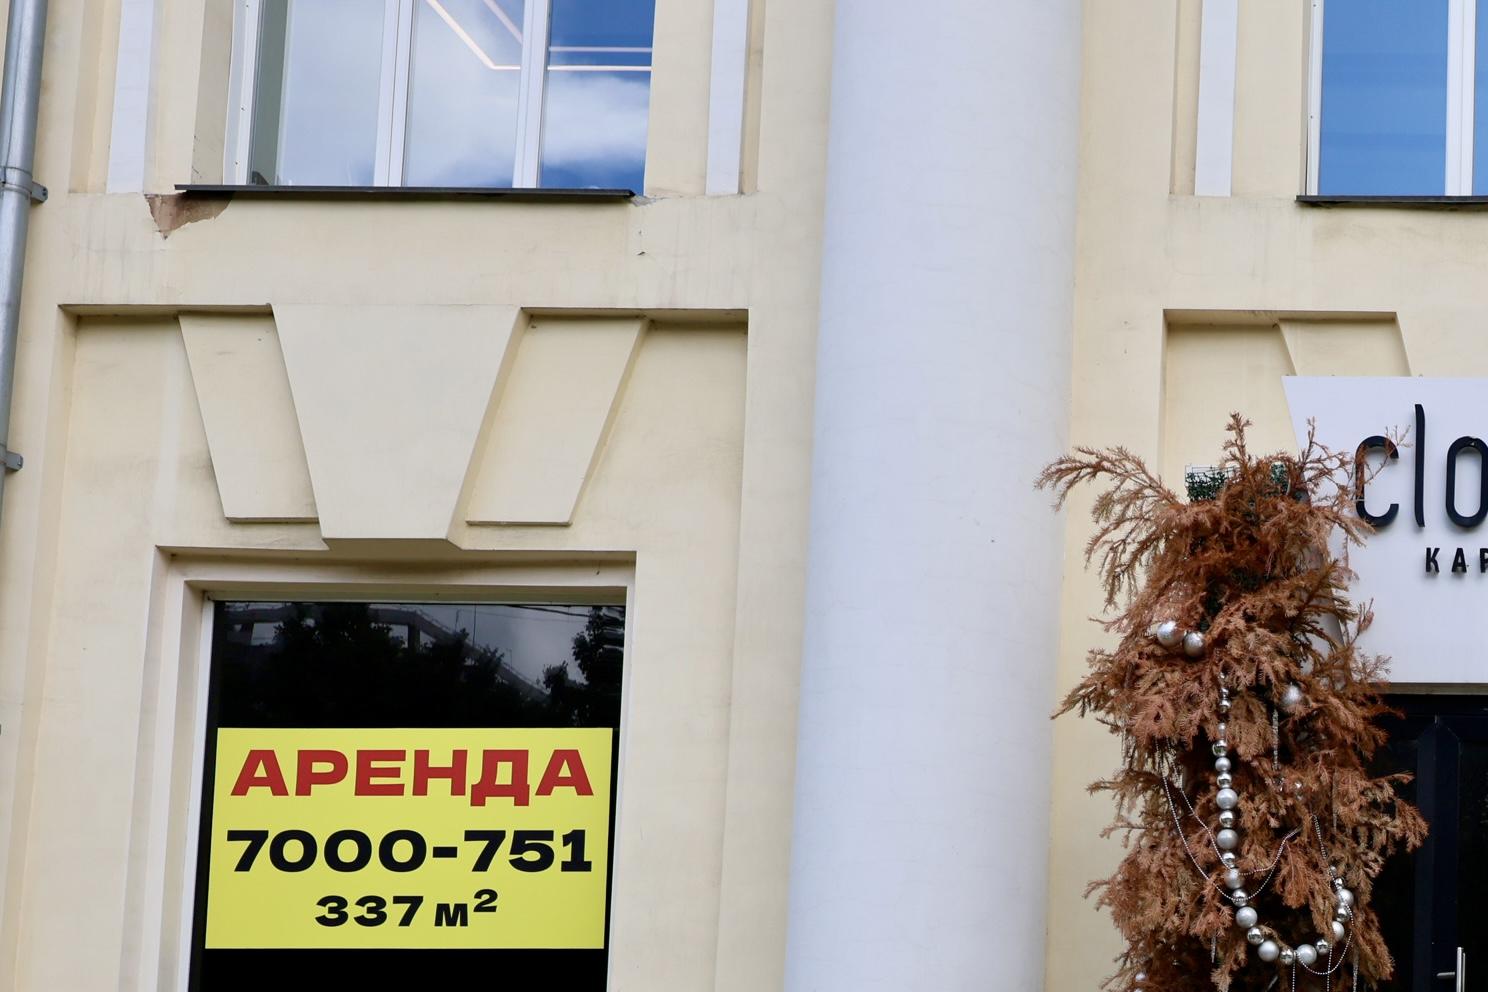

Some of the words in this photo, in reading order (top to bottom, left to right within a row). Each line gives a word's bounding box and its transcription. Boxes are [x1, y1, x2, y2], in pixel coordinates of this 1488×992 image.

[230, 749, 594, 807] АРЕНДА
[226, 829, 592, 872] 7000-751
[315, 895, 424, 927] 337
